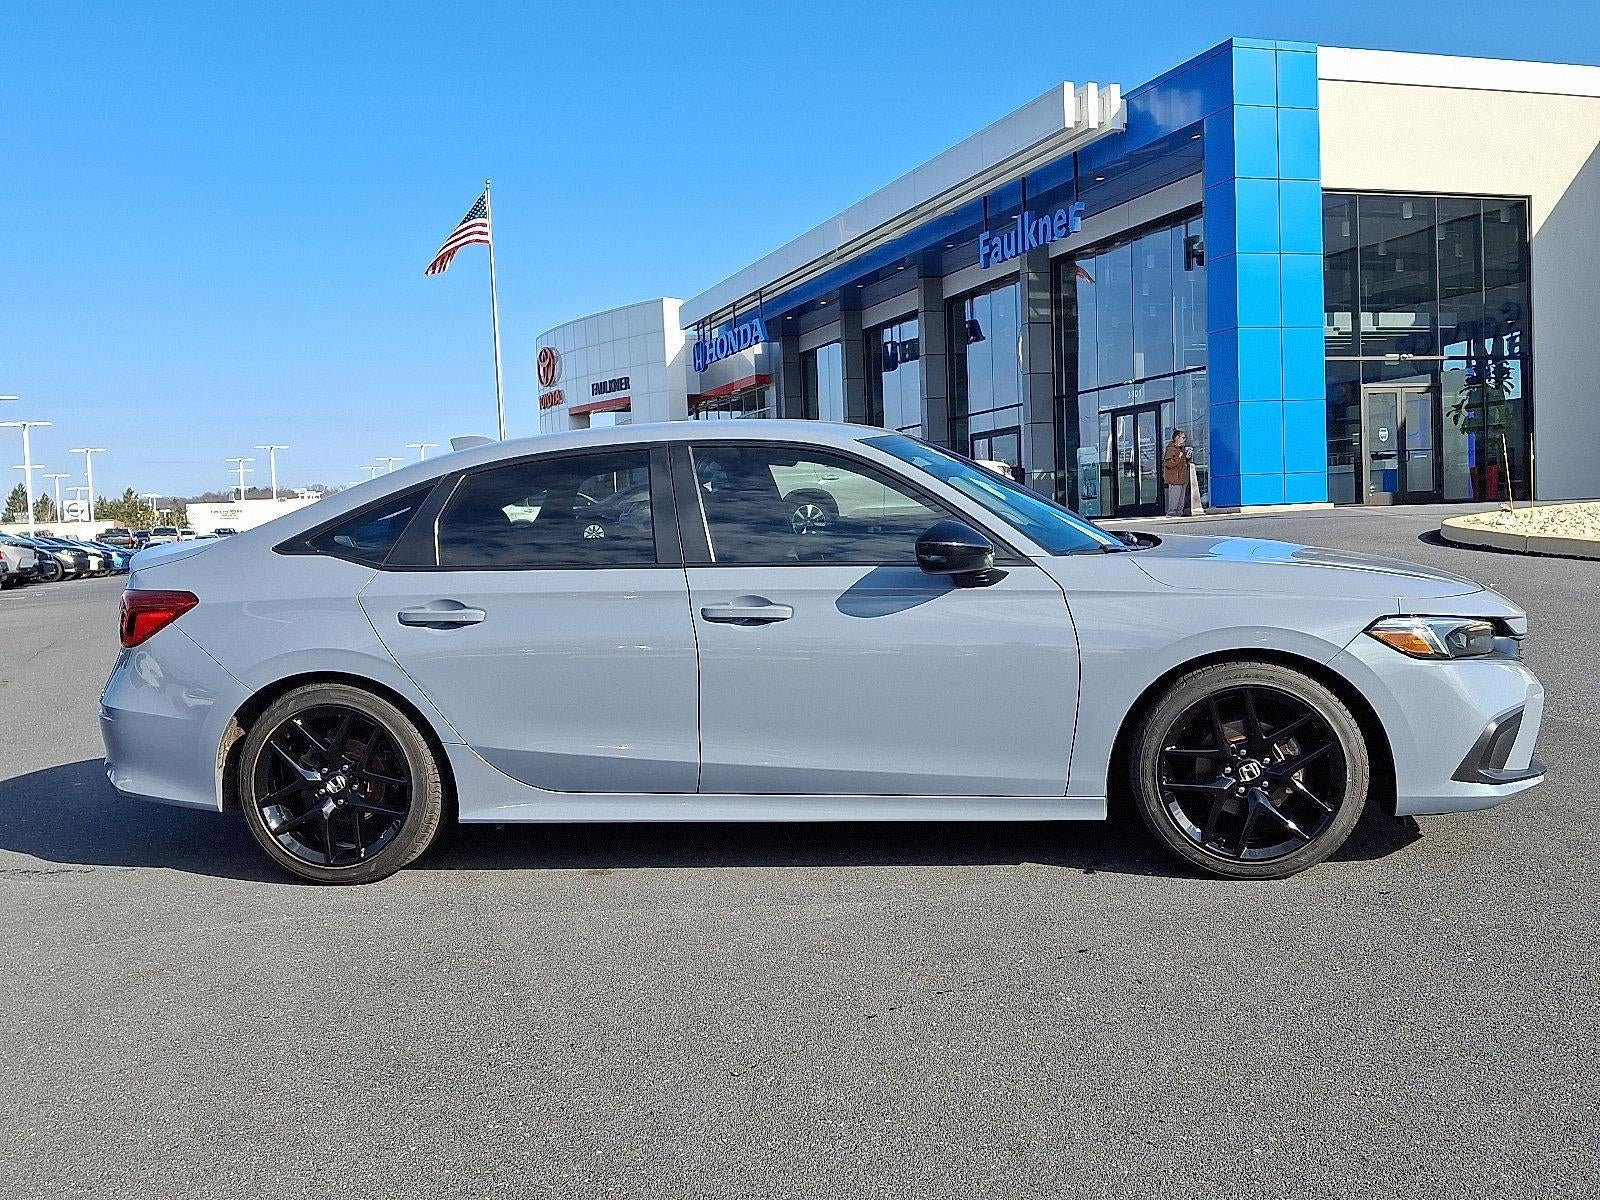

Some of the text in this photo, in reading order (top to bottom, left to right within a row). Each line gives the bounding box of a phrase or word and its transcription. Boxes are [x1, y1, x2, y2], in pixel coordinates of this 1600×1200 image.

[979, 201, 1086, 269] Faulkner
[705, 317, 767, 365] HONDA
[539, 389, 565, 410] TOYOTA
[591, 376, 631, 396] FAULKNER
